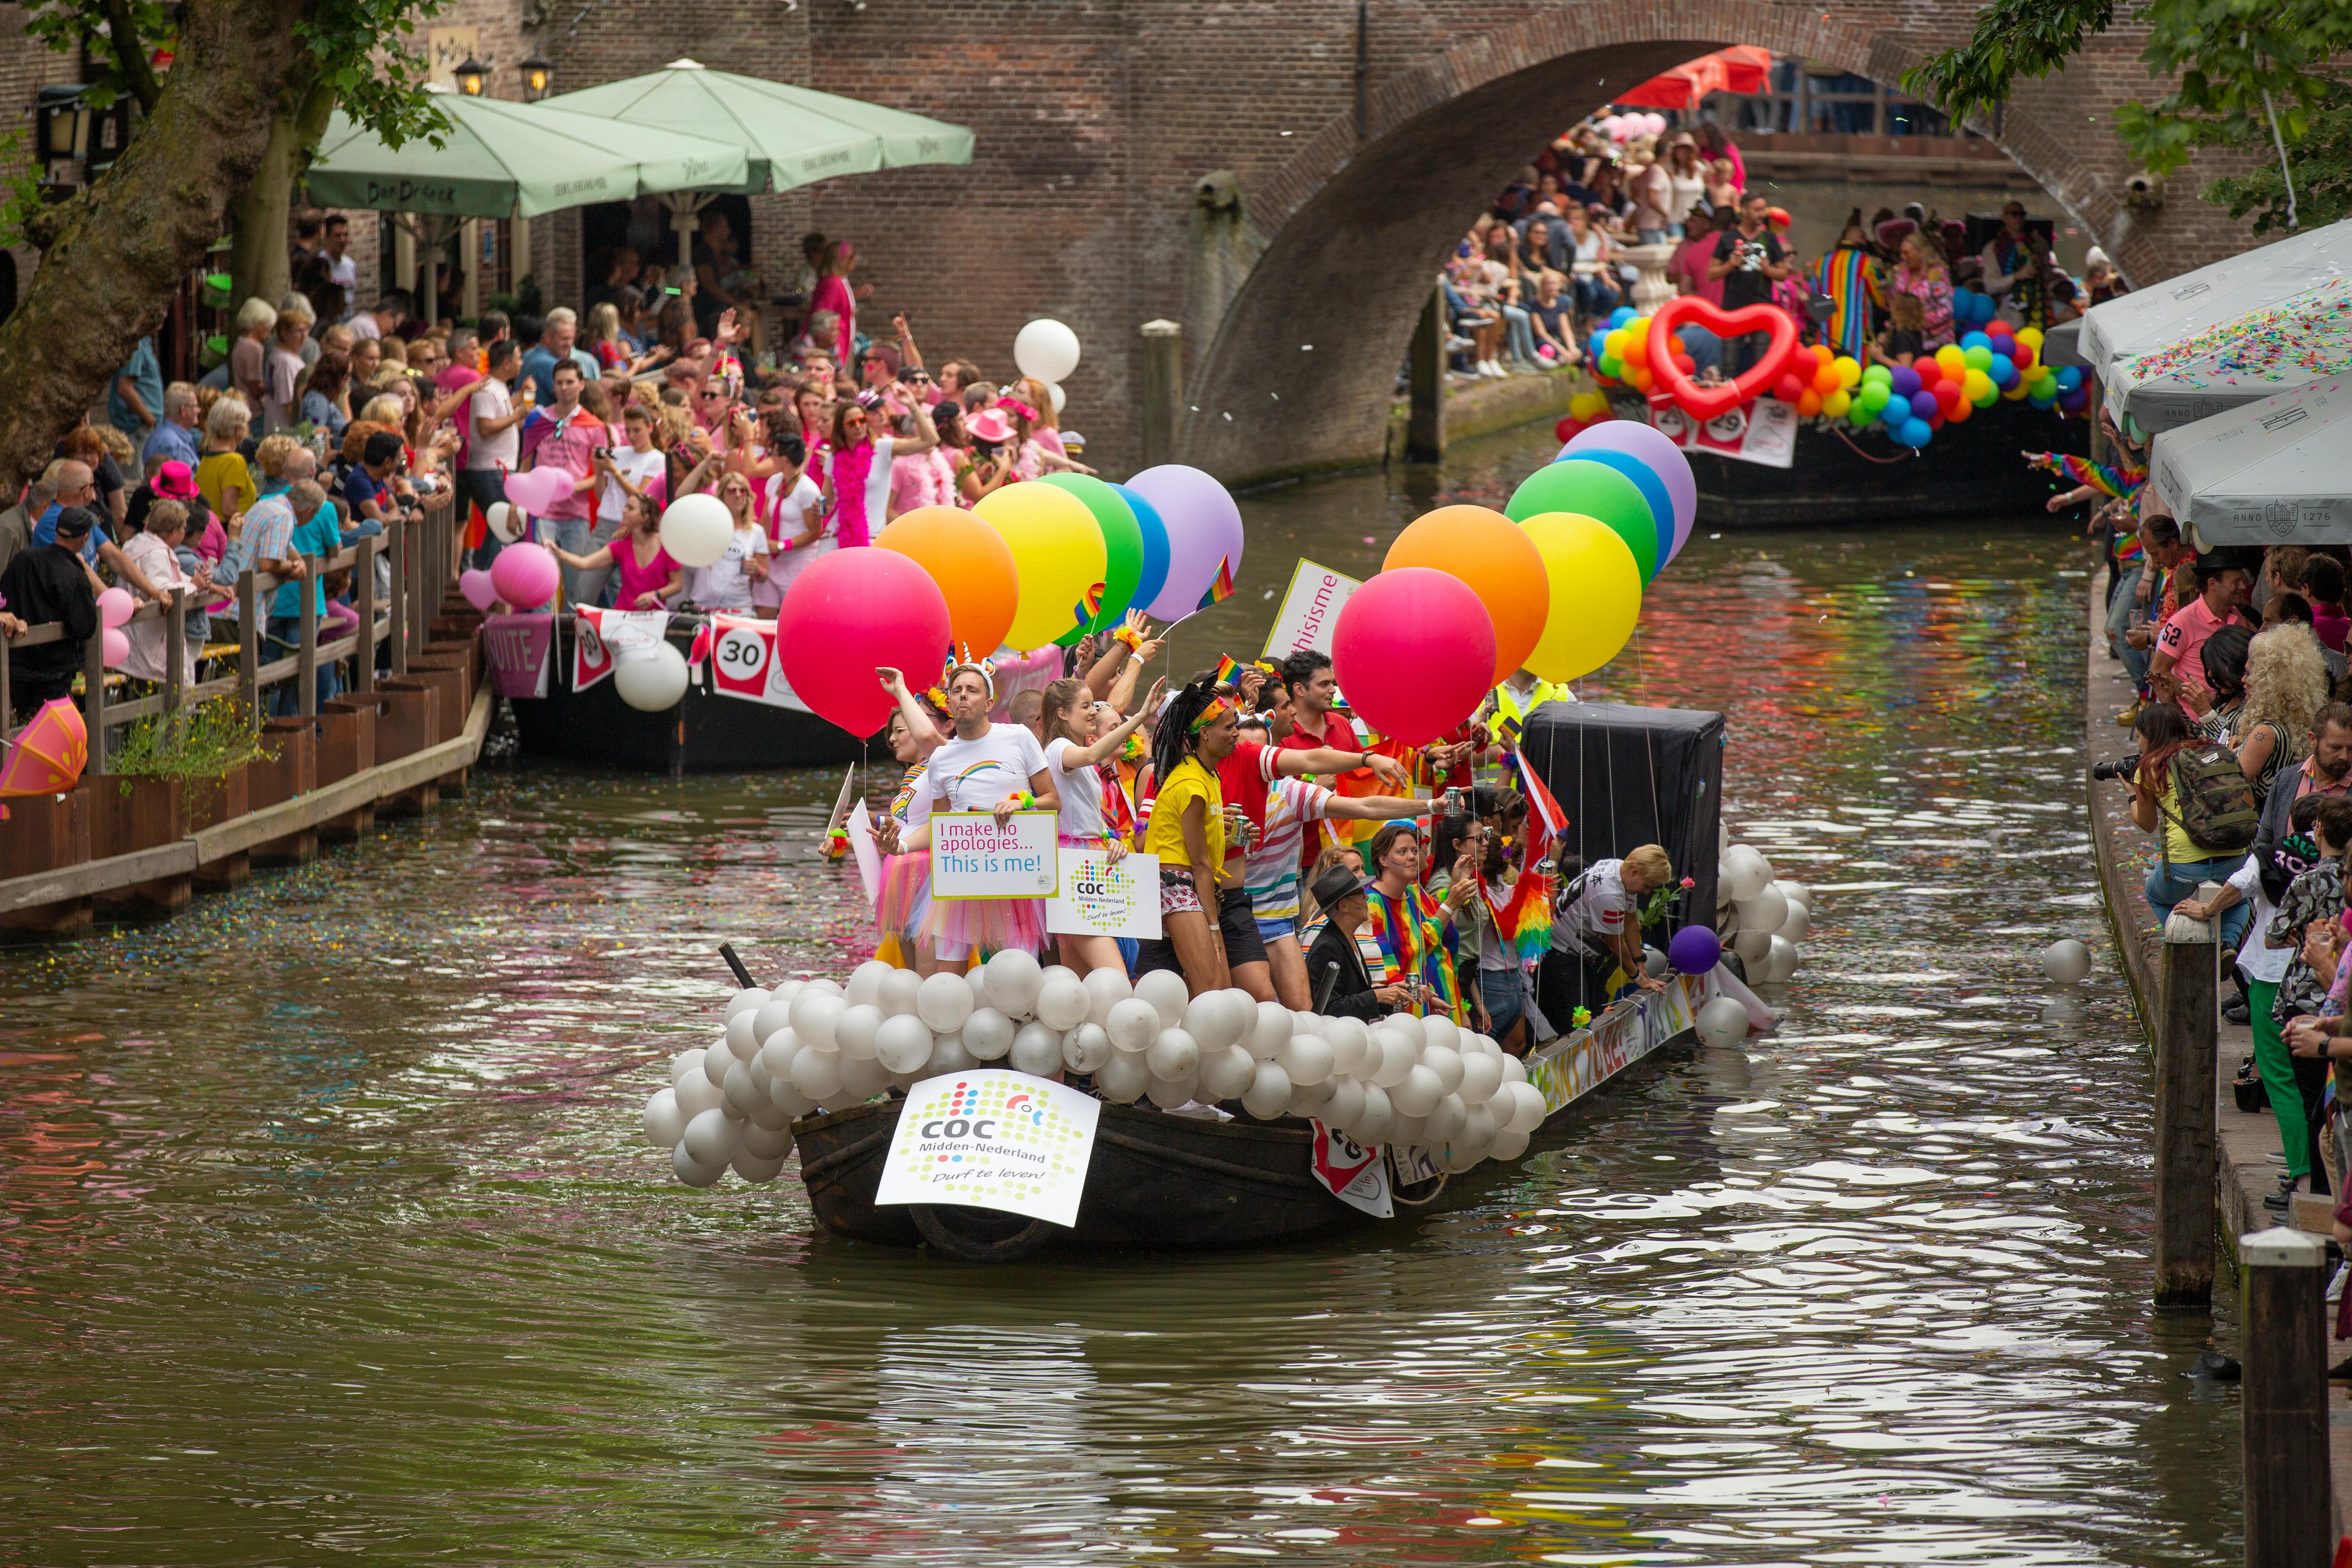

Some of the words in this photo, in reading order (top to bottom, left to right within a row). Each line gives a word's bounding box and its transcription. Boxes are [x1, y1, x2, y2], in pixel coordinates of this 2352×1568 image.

[2234, 514, 2262, 522] ANNO
[2163, 623, 2181, 647] 52
[487, 629, 536, 673] UITE
[722, 640, 760, 666] 30
[941, 823, 944, 836] I
[949, 822, 992, 836] make
[998, 824, 1017, 835] no
[941, 835, 1033, 854] apologies...
[940, 855, 979, 873] This
[985, 854, 998, 872] is
[1004, 855, 1041, 872] me!
[1077, 883, 1104, 895] COC
[1078, 896, 1125, 904] Midden-Nederland
[1087, 912, 1101, 920] Durf
[1110, 908, 1126, 916] leven!
[1582, 1031, 1604, 1088] TO
[922, 1119, 996, 1139] COC
[919, 1142, 1045, 1163] Midden-Nederland
[932, 1169, 975, 1183] Durf
[977, 1170, 993, 1178] te
[998, 1168, 1046, 1179] leven!
[1351, 1184, 1363, 1193] CLOUD
